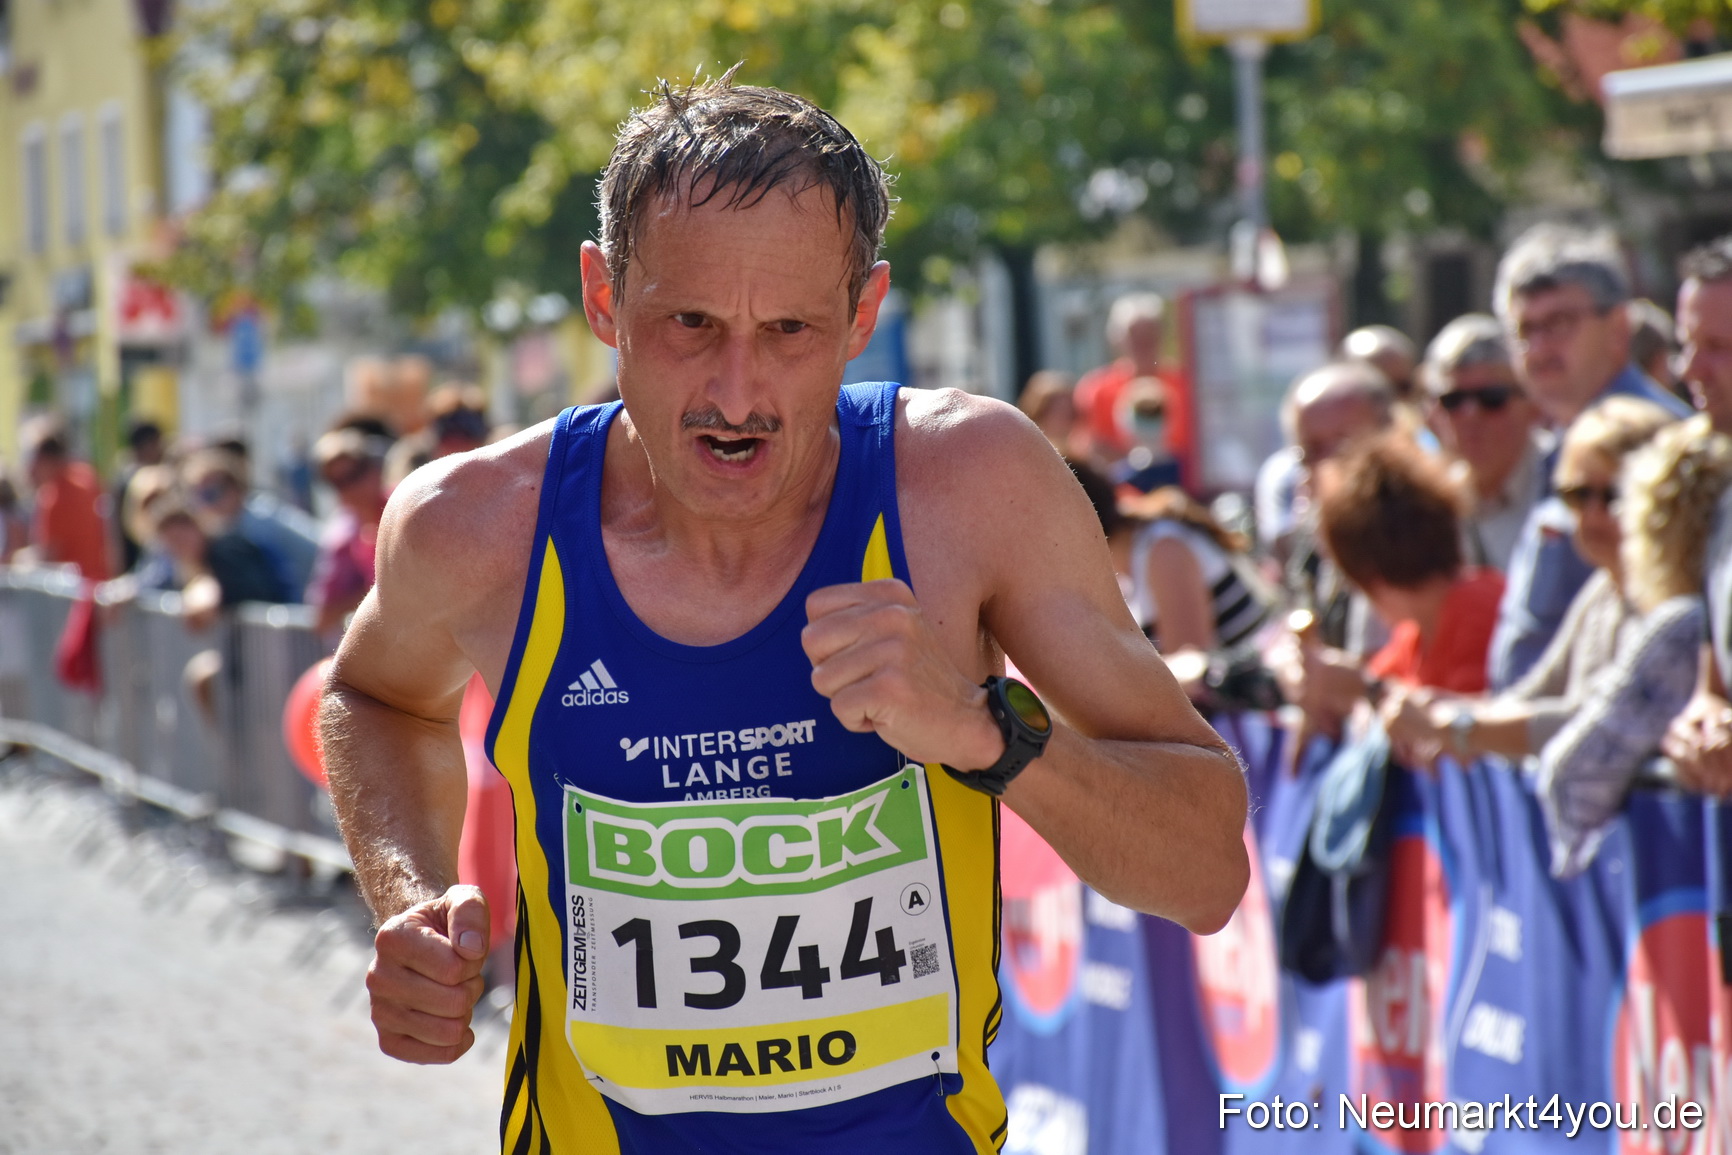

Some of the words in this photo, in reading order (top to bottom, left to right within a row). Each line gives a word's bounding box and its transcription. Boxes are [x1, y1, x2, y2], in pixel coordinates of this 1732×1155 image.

[561, 688, 630, 707] adidas
[653, 719, 817, 760] INTERSPORT
[661, 752, 793, 788] LANGE
[684, 784, 771, 802] AMBERG
[588, 789, 900, 887] BOCK
[907, 889, 926, 910] A
[588, 897, 597, 950] ZEITMESSUNG
[611, 896, 907, 1010] 1344
[664, 1030, 857, 1078] MARIO
[798, 1087, 826, 1097] Startblock
